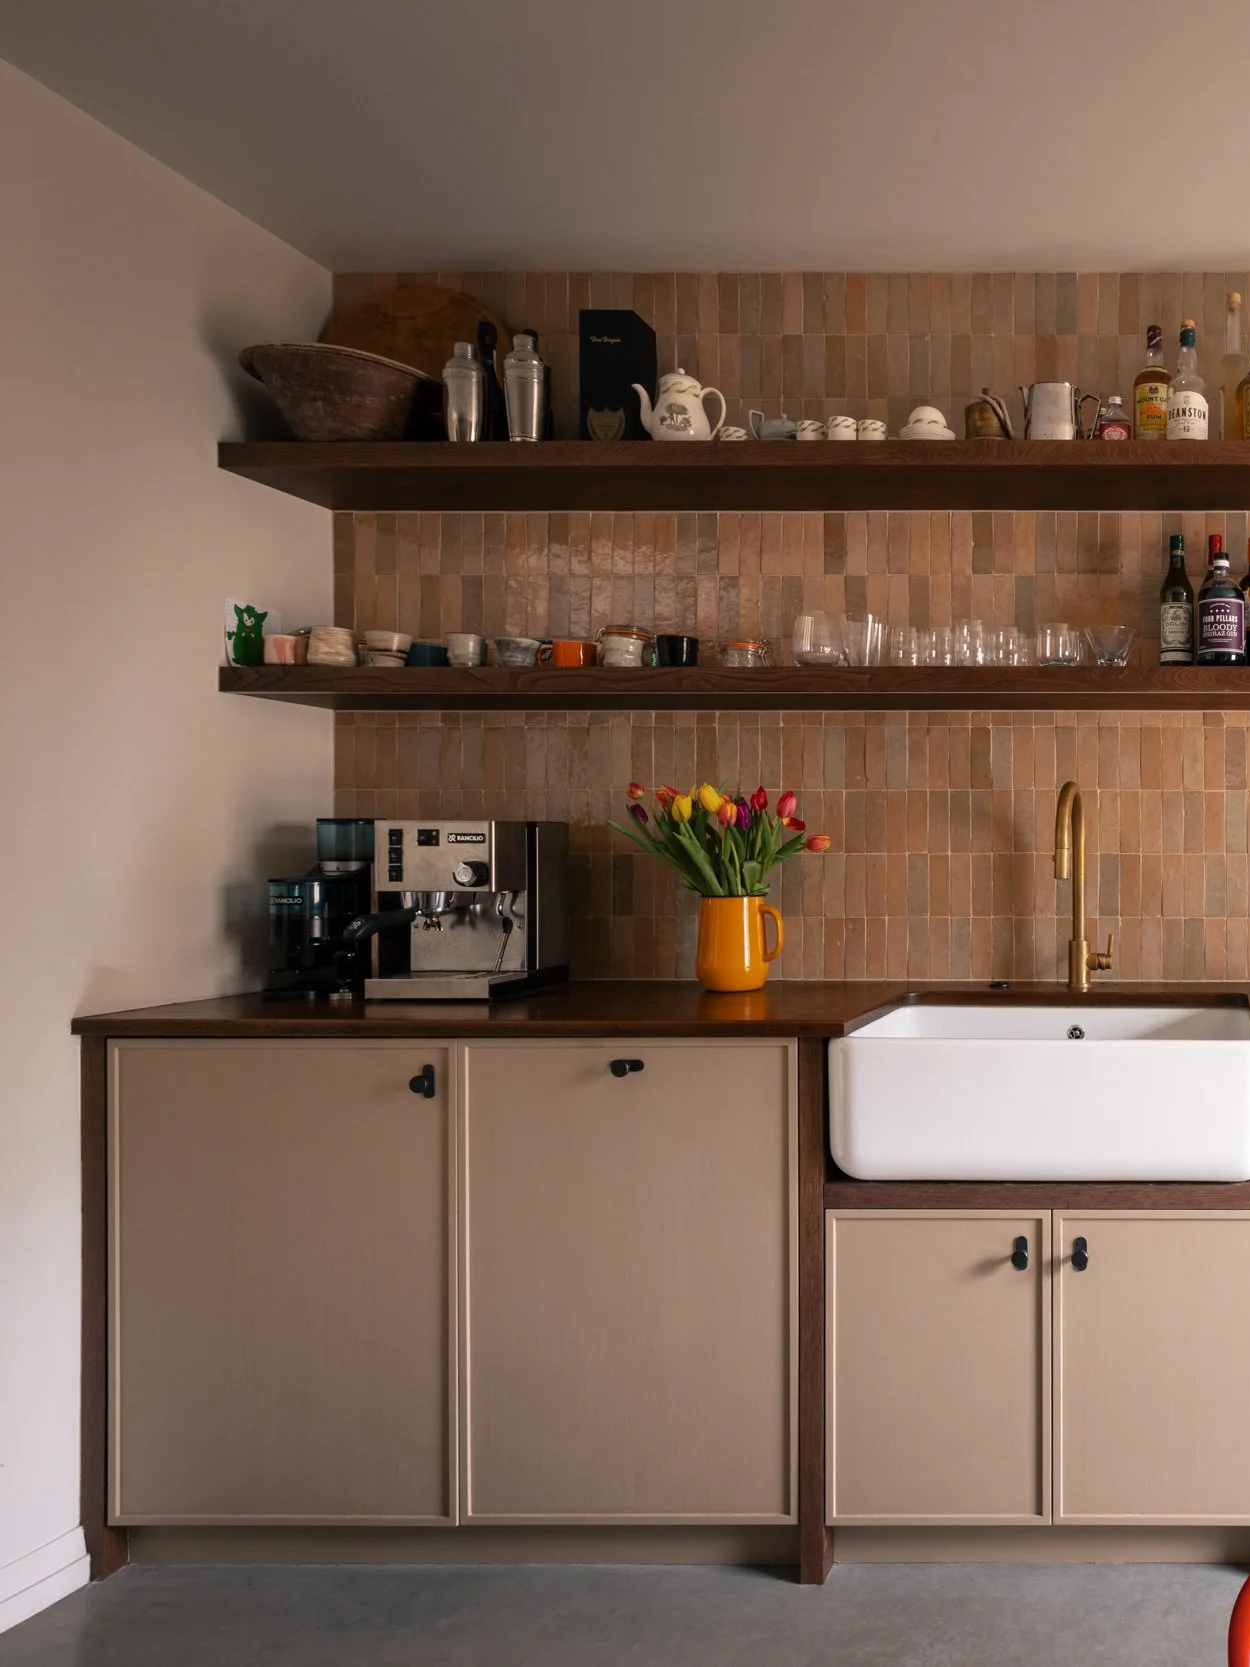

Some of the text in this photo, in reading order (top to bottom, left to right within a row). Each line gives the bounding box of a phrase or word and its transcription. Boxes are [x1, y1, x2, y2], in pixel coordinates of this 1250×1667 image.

[1168, 406, 1207, 421] DEANSTON
[1202, 614, 1238, 623] FOUR PILLARS
[1203, 623, 1238, 632] BLOODY
[456, 834, 484, 842] RANCILIO
